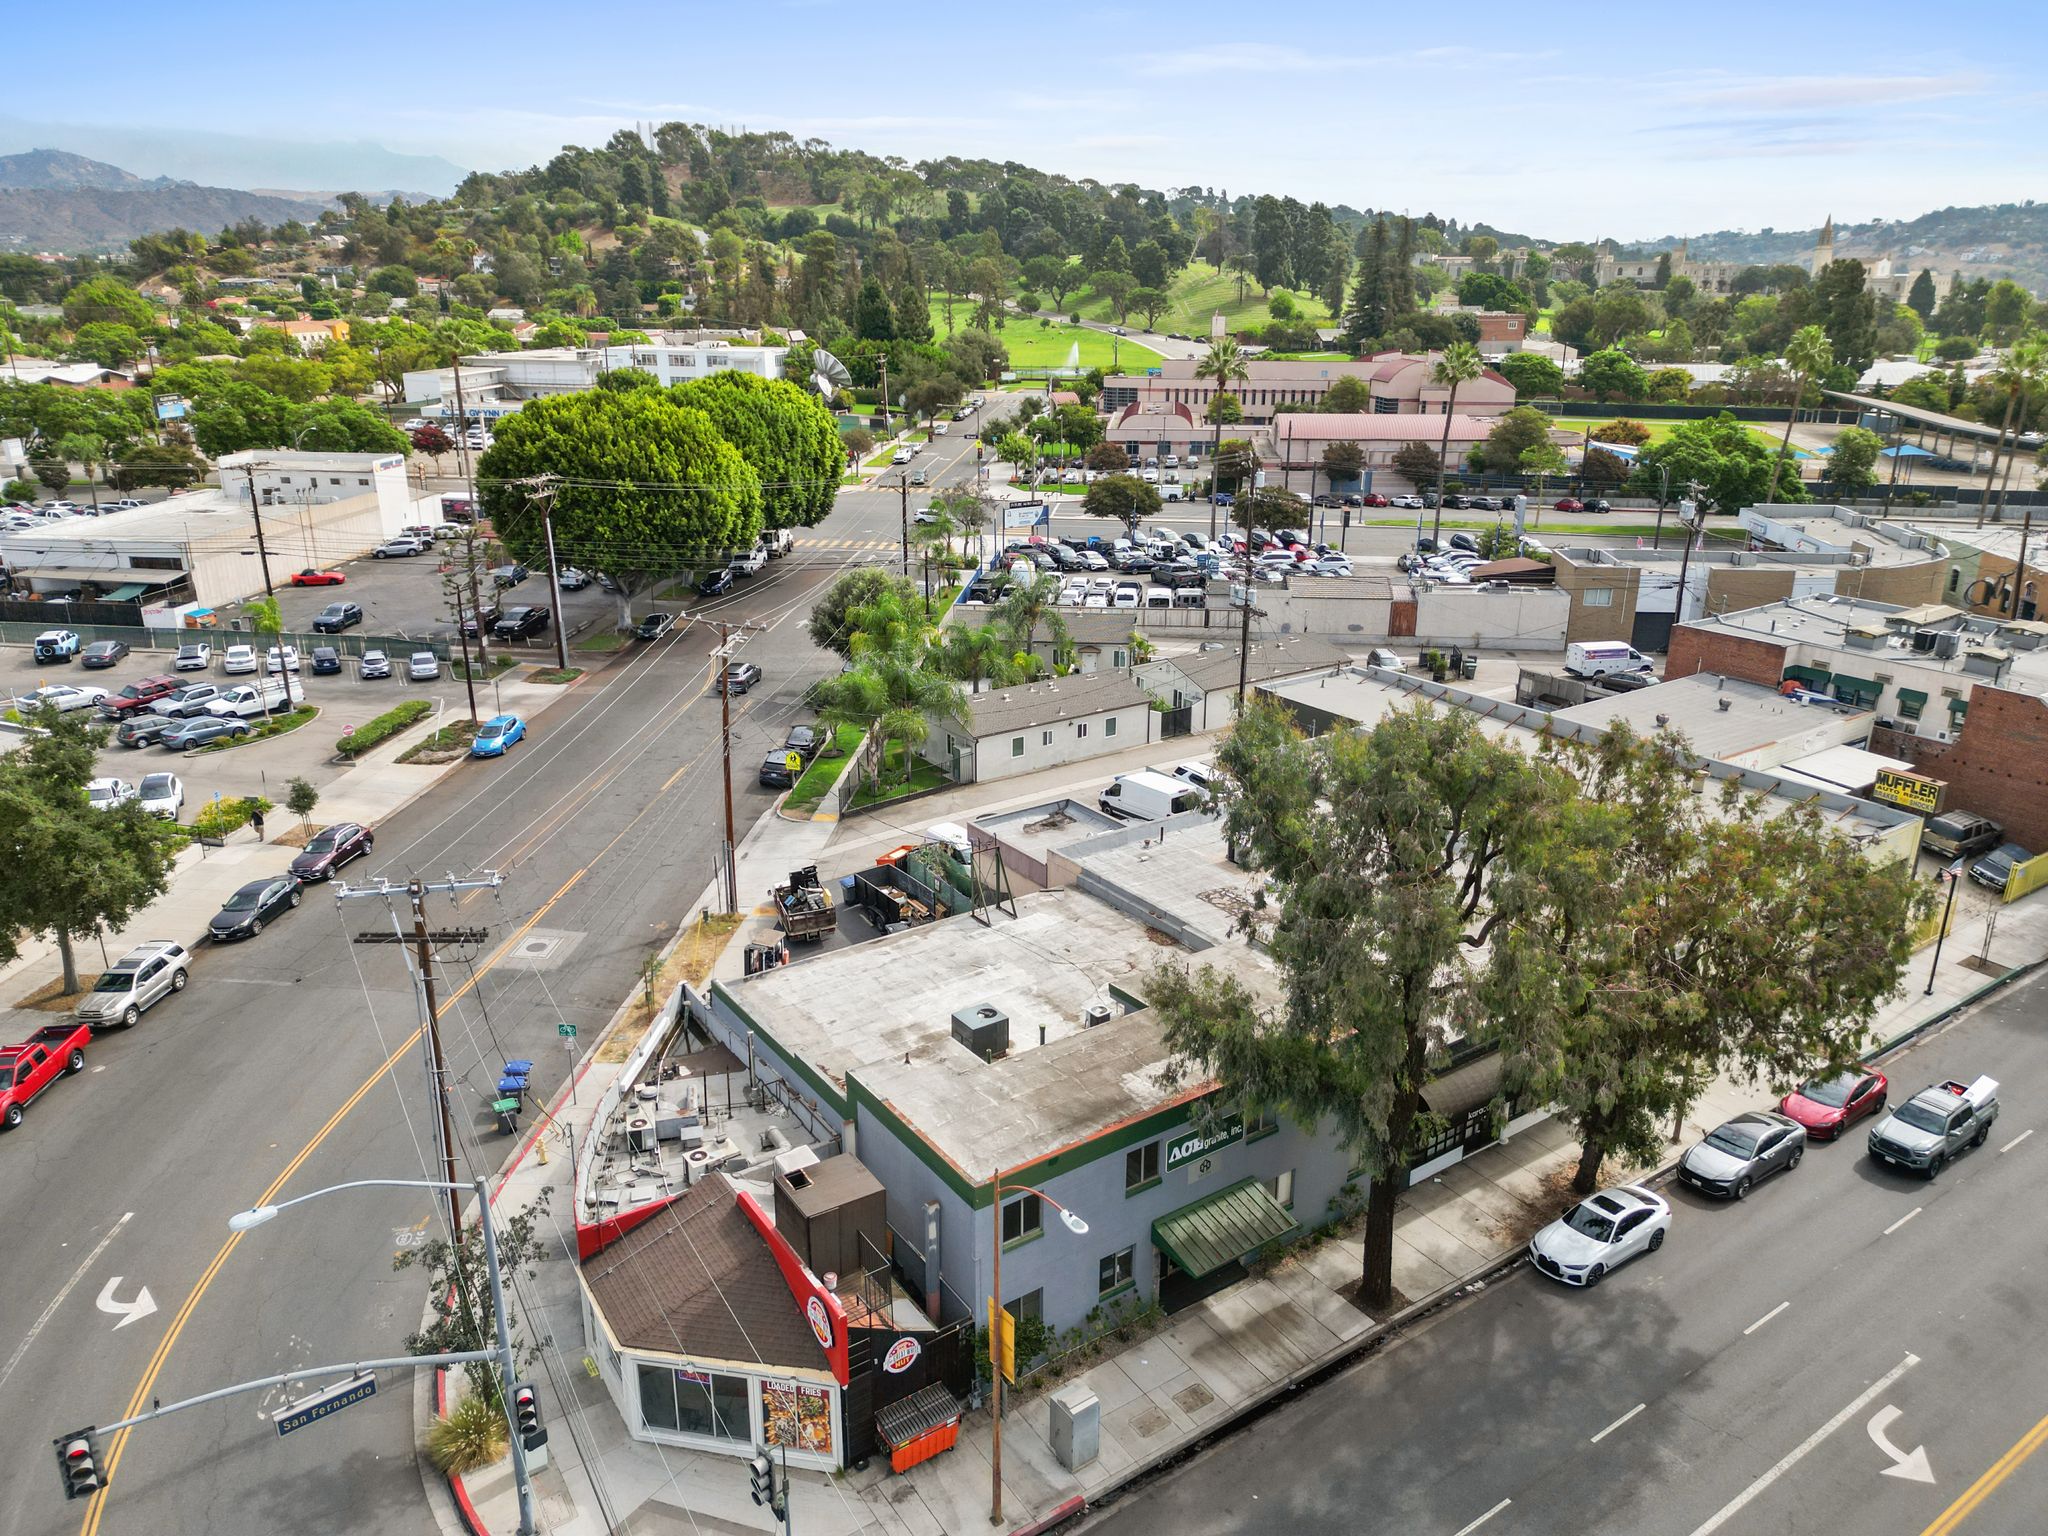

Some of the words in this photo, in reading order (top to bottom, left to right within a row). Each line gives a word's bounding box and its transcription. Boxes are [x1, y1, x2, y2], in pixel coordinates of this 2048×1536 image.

[1876, 771, 1938, 799] MUFFLER
[1877, 785, 1900, 795] AUTO
[1903, 792, 1934, 804] REPAIR
[1204, 1131, 1229, 1150] grante,
[894, 1356, 911, 1369] HUT
[681, 1370, 710, 1382] OPEN
[767, 1380, 794, 1393] LOADED
[801, 1386, 822, 1397] FRIES
[282, 1415, 308, 1431] San
[311, 1386, 373, 1418] Fernando
